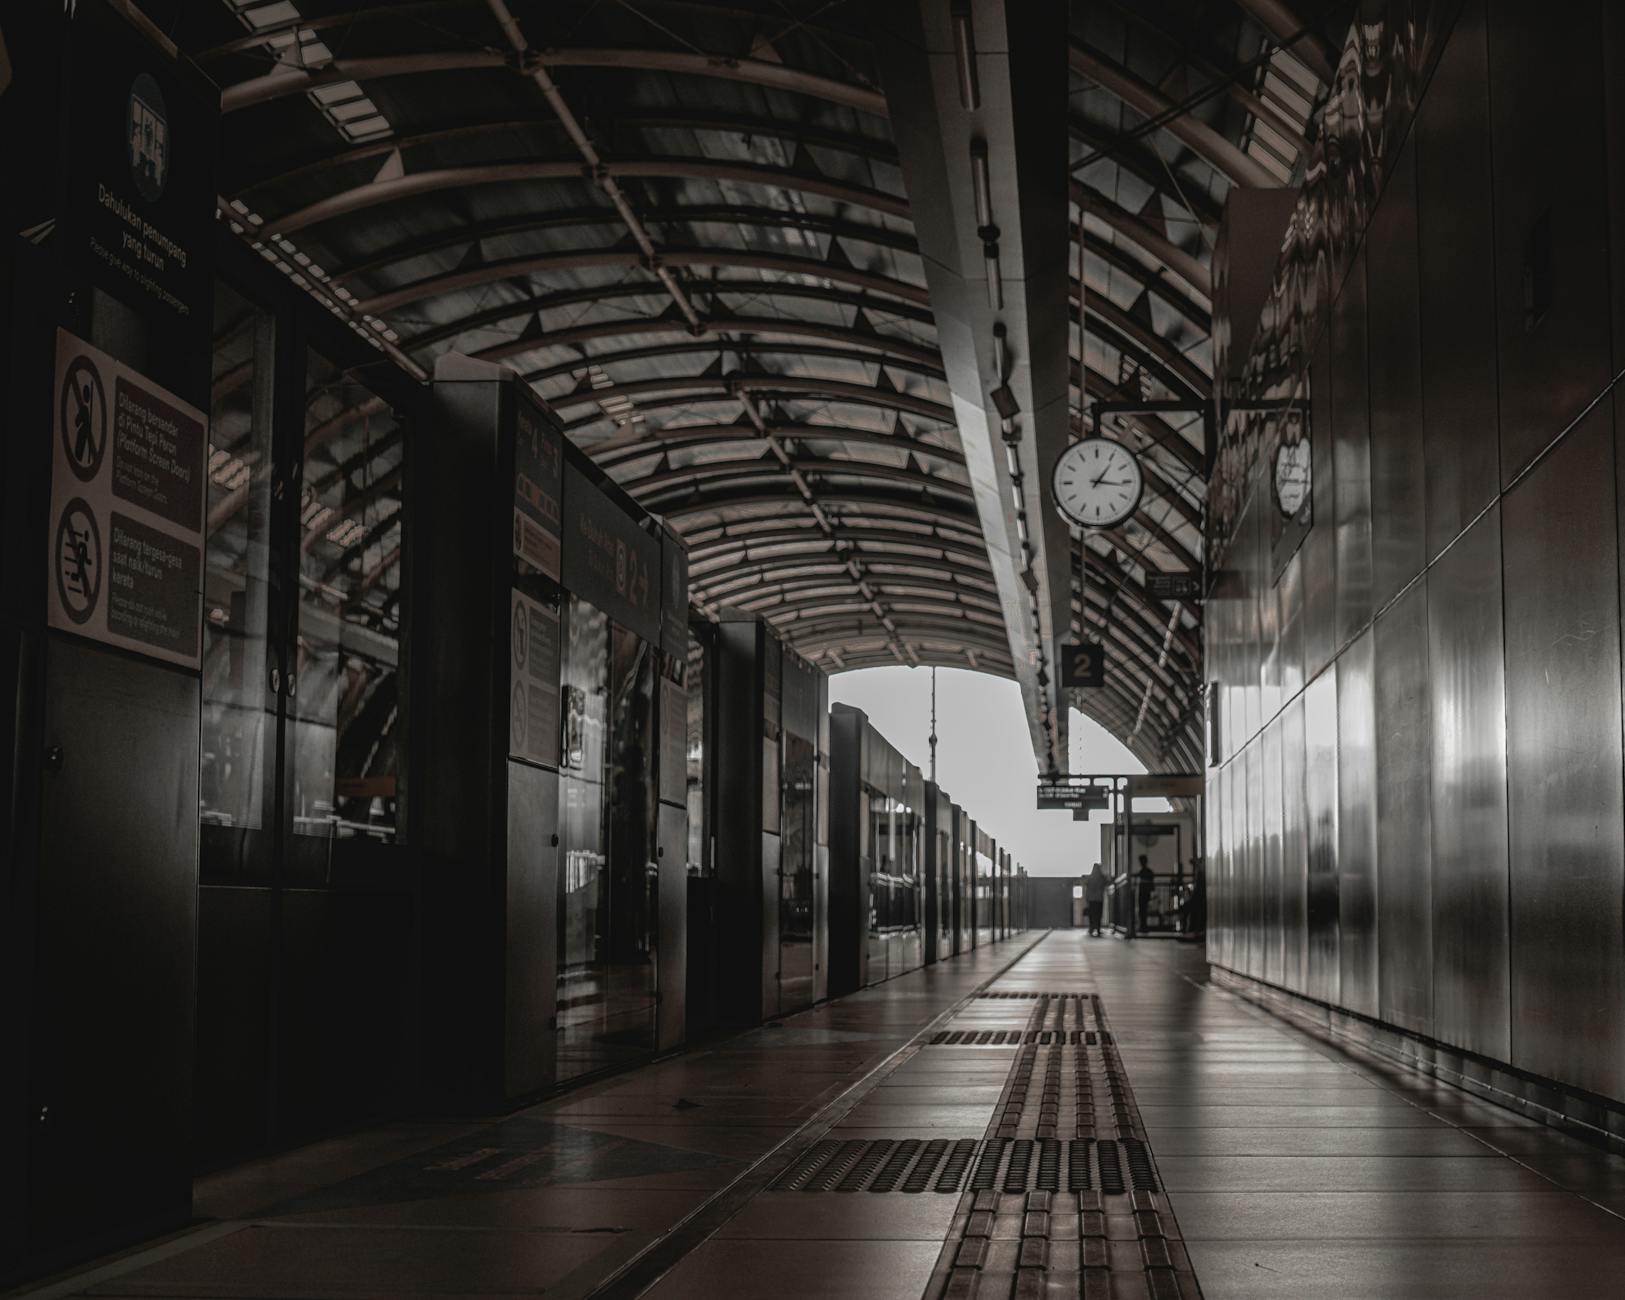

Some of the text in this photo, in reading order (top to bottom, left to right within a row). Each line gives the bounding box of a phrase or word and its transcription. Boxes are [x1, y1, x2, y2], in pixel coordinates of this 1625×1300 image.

[98, 183, 187, 269] Dahulukan penumpang
[122, 231, 165, 271] yang turun
[119, 391, 147, 425] Dilarang
[113, 527, 142, 562] Dilarang
[1073, 653, 1091, 678] 2
